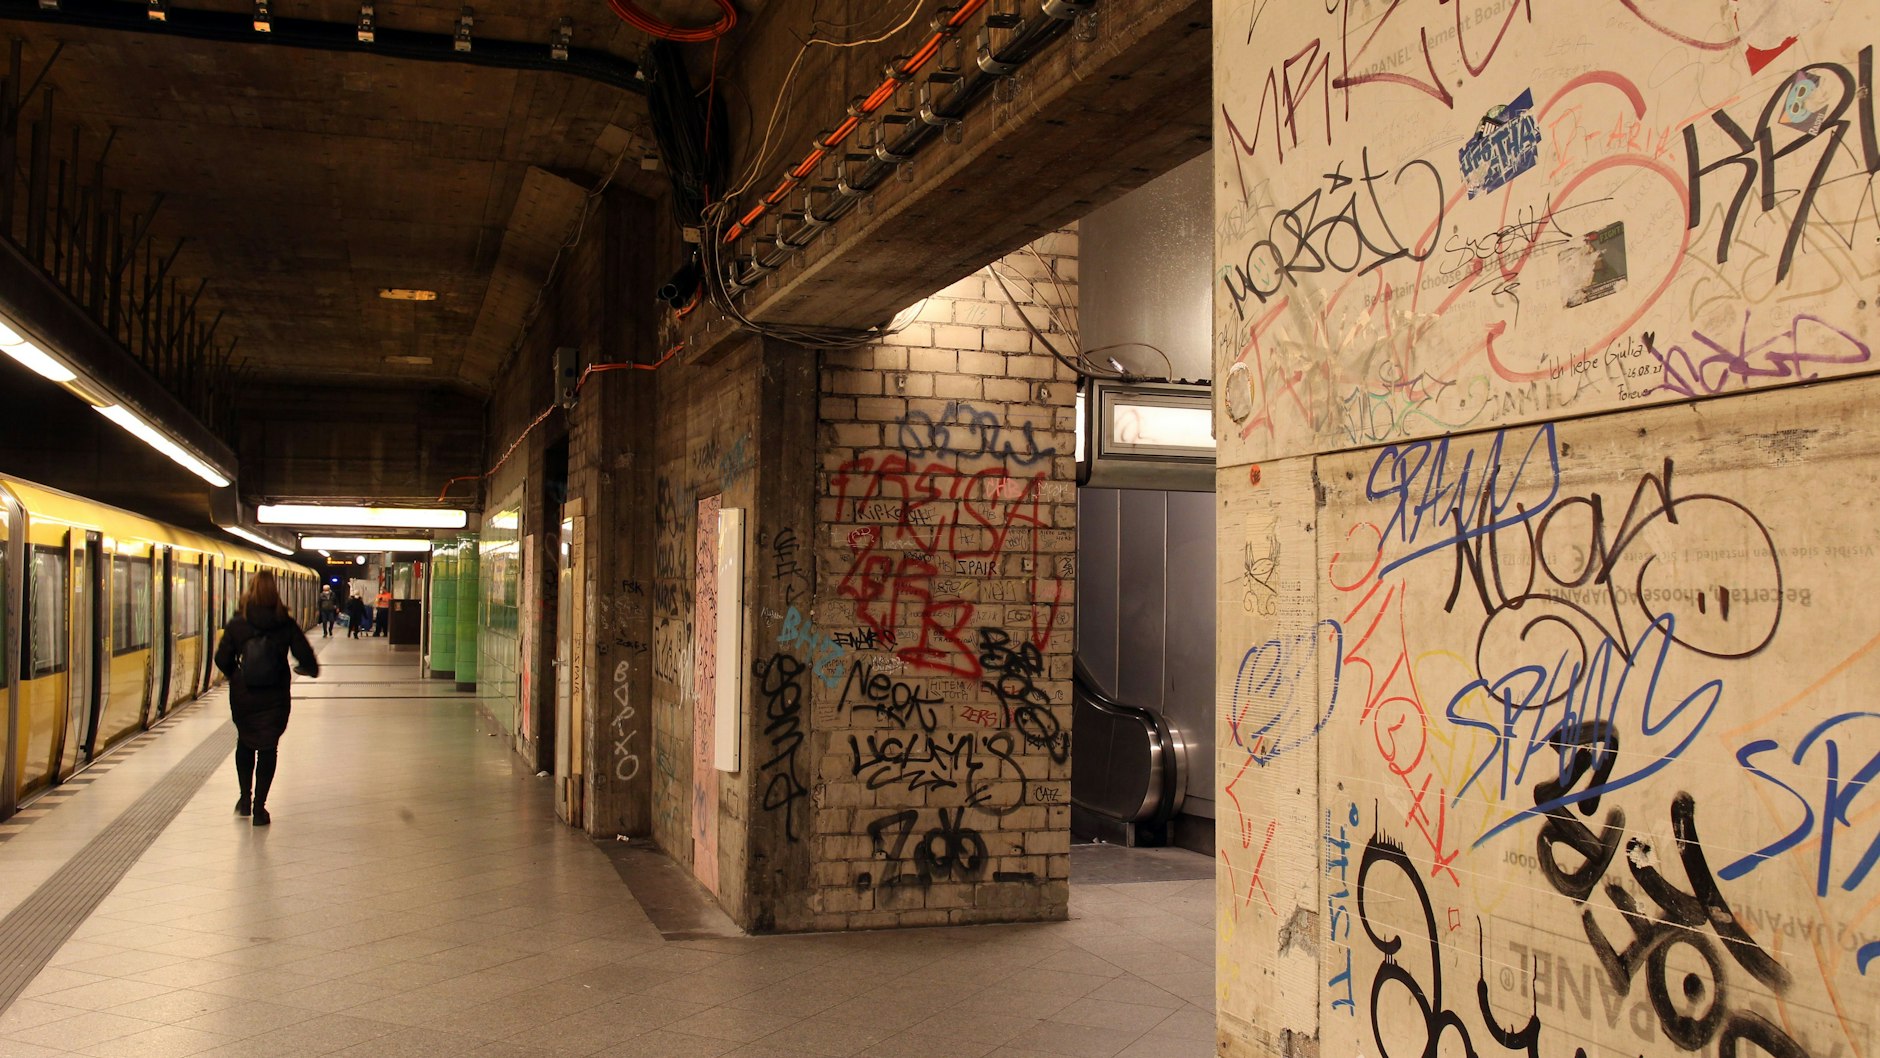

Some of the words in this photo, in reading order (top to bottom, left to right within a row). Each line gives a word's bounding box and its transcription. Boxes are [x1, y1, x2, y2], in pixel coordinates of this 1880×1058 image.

[1549, 356, 1564, 381] Ich
[1570, 347, 1599, 377] liebe
[1604, 336, 1643, 368] Giulia
